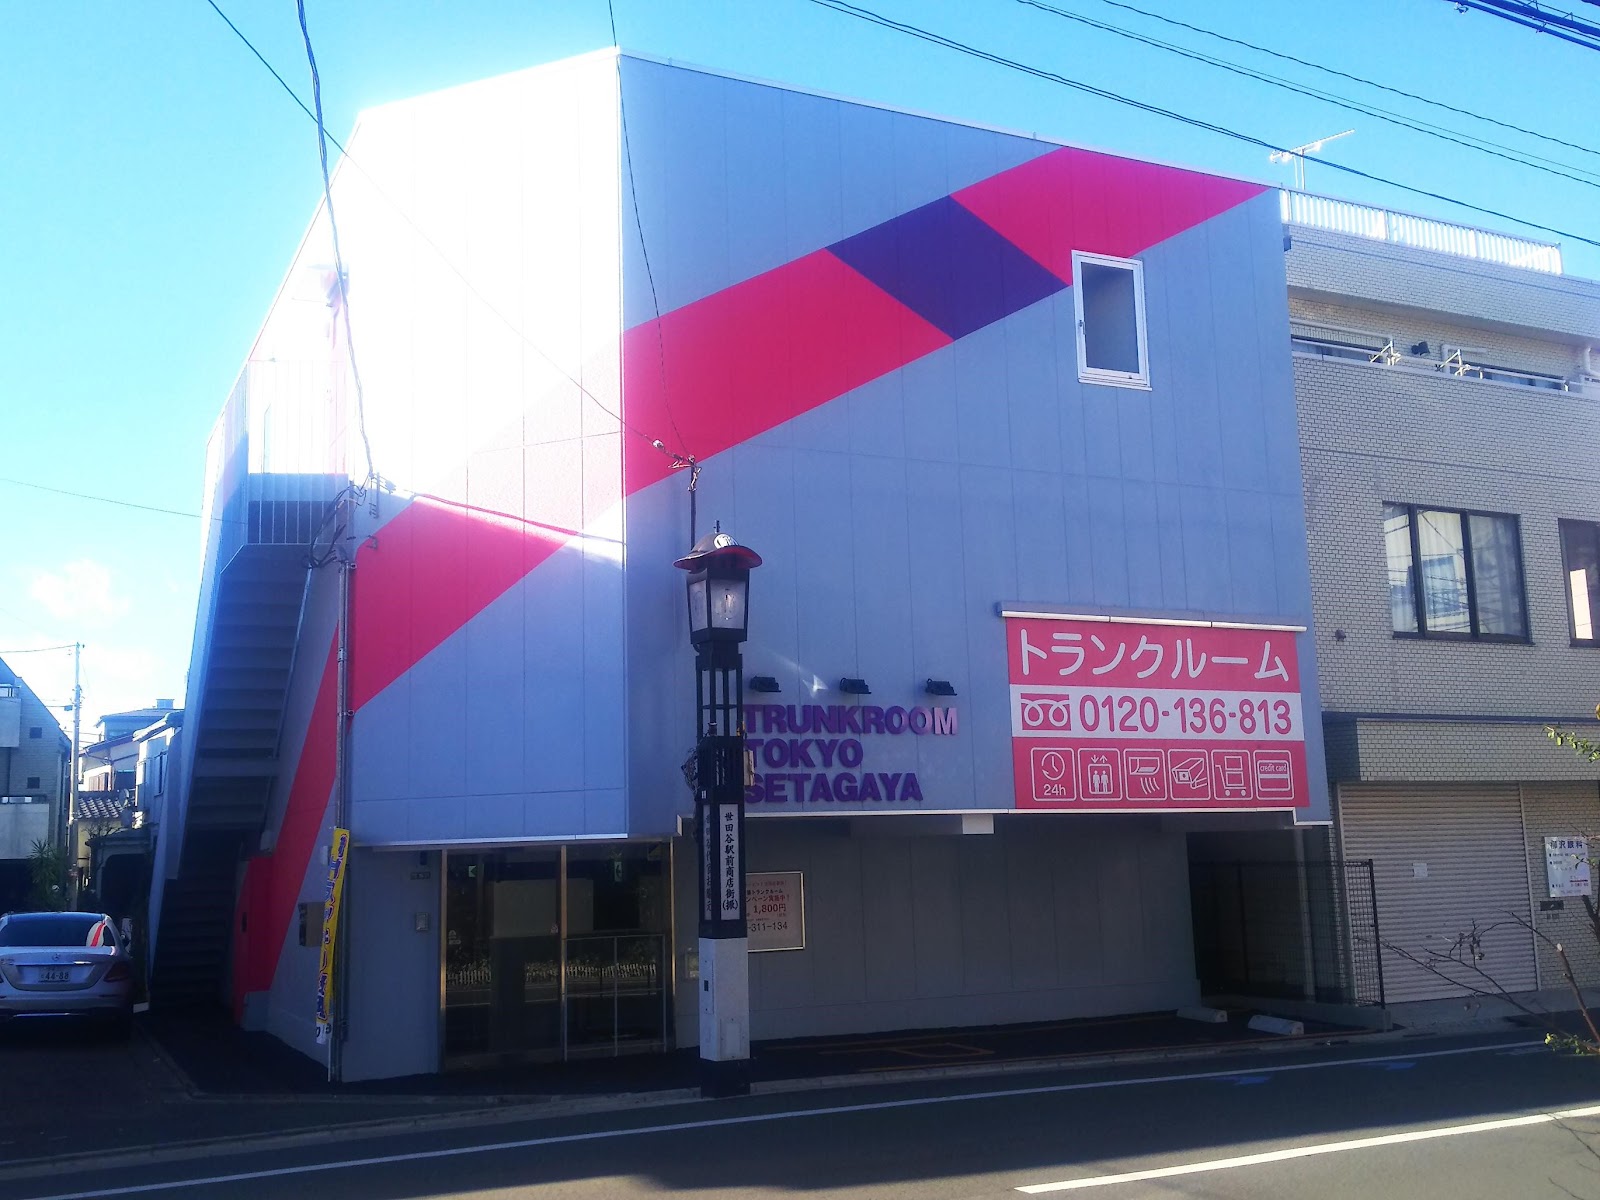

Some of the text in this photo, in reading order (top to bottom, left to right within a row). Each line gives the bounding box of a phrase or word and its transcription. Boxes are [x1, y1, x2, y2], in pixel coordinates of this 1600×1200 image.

[1020, 628, 1289, 682] トランクルーム
[744, 704, 957, 736] TRUNKROOM
[1079, 694, 1292, 735] 0120-136-813
[744, 738, 864, 769] TOKYO
[1259, 764, 1287, 773] credit card
[744, 772, 923, 804] SETAGAYA
[1043, 783, 1066, 796] 24h
